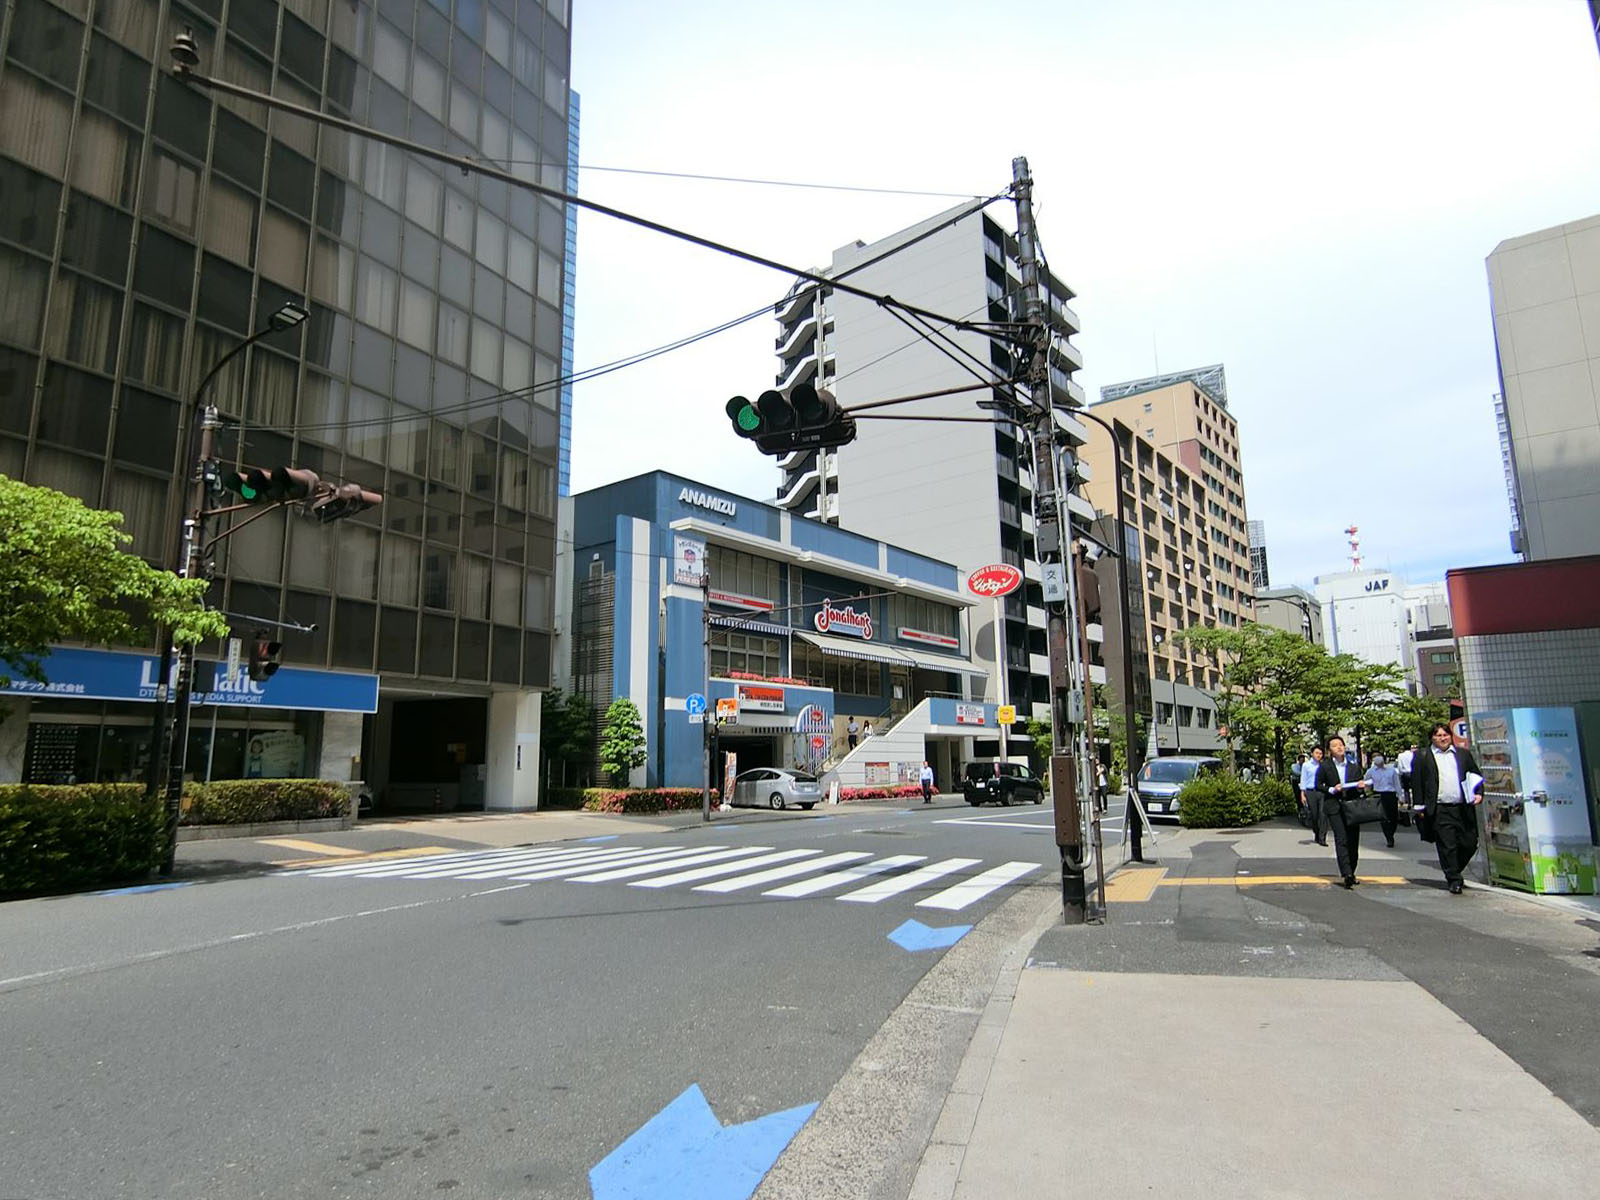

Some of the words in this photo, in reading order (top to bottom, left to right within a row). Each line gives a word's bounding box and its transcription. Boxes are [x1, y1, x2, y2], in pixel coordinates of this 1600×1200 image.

[678, 487, 737, 516] ANAMIZU
[1364, 579, 1389, 592] JAF
[226, 694, 263, 703] SUPPORT
[690, 699, 699, 715] P
